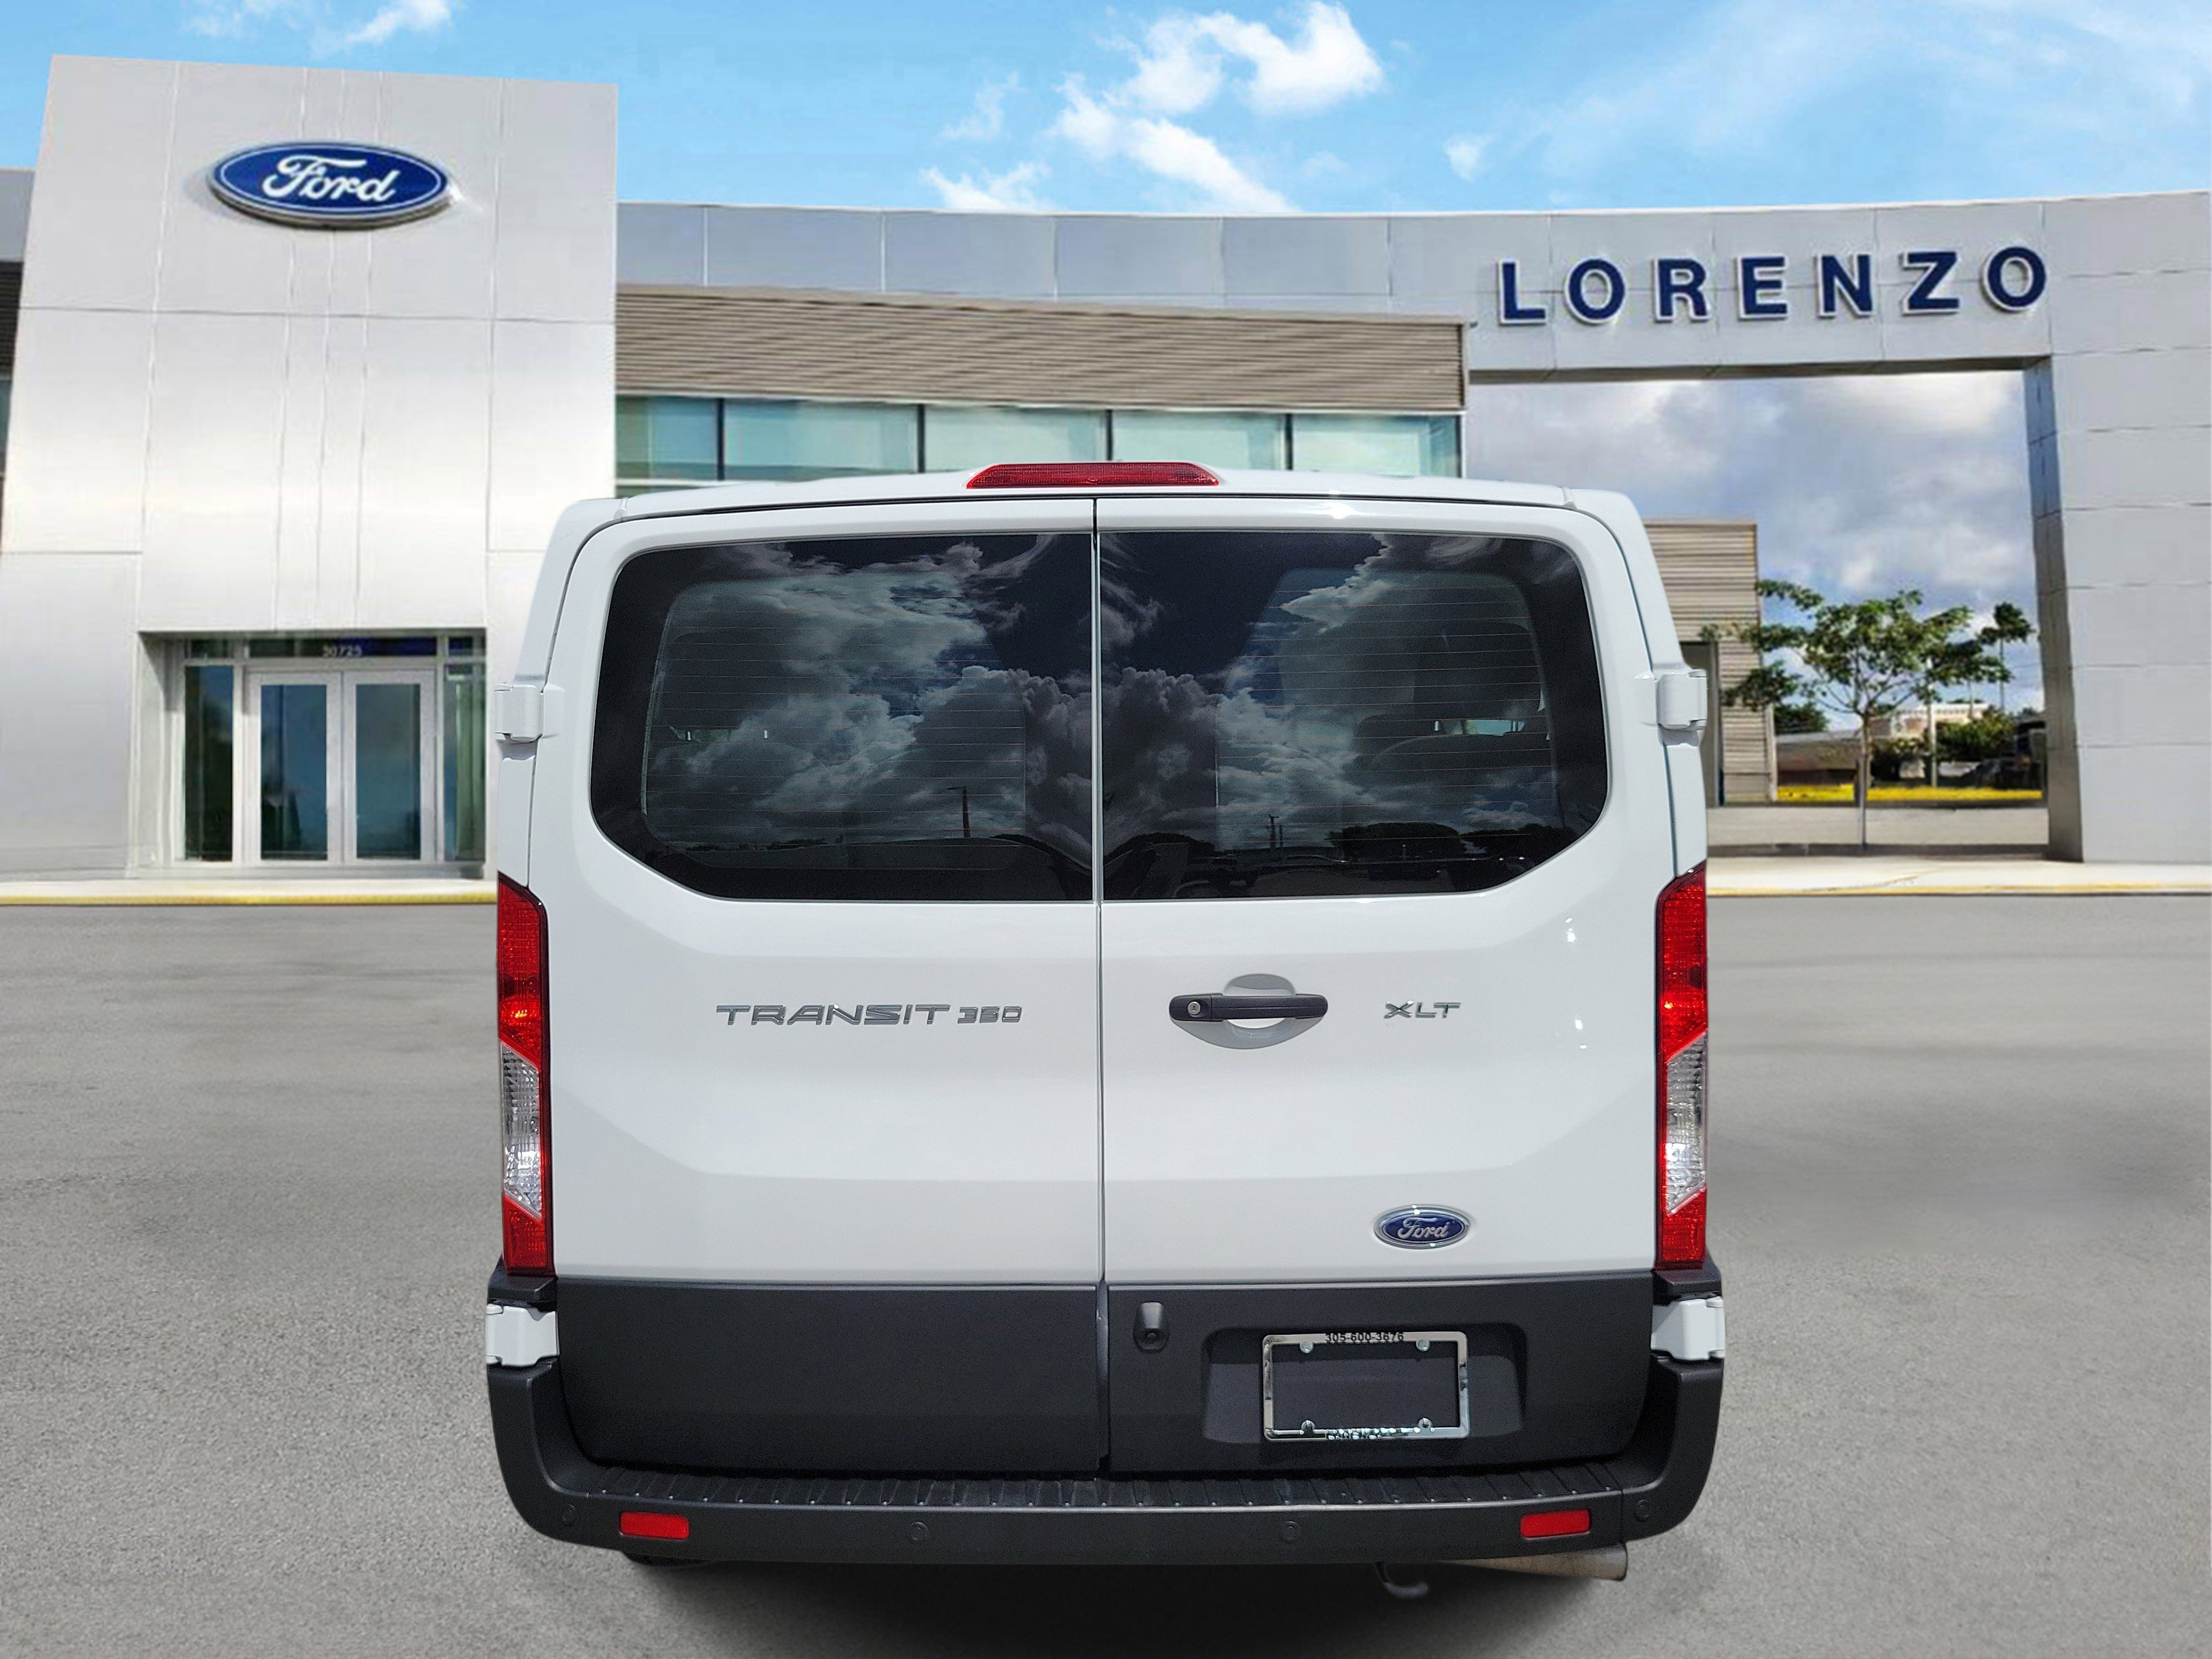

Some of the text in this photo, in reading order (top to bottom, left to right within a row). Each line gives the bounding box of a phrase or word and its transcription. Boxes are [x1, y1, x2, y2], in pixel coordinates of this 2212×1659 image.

[262, 154, 401, 202] Ford
[1499, 246, 2047, 322] LORENZO
[716, 1004, 950, 1026] TRANSIT
[1384, 1000, 1461, 1019] XLT
[1397, 1217, 1451, 1239] Ford
